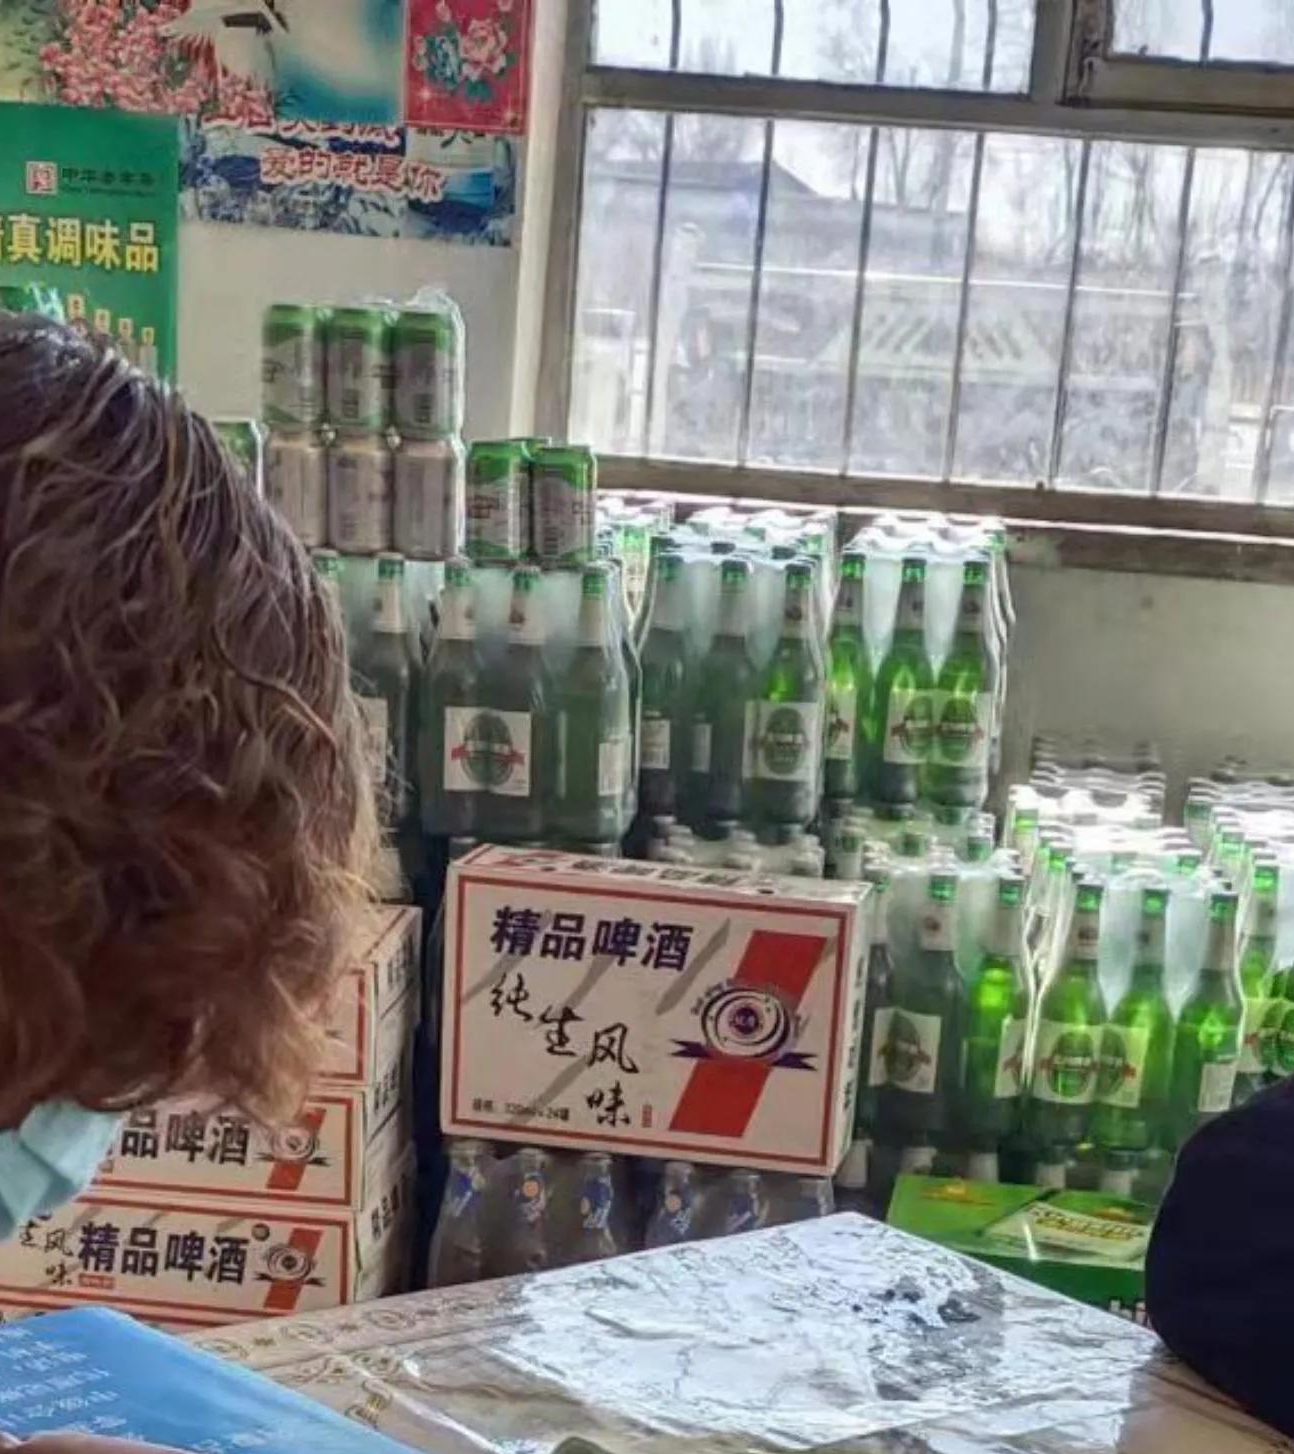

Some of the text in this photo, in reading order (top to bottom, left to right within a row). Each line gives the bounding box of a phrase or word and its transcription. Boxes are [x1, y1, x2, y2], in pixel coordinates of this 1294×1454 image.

[263, 148, 444, 200] 爱的就是你
[490, 905, 695, 971] 精品啤酒
[490, 972, 639, 1127] 纯生风味
[120, 1109, 251, 1167] 品啤酒
[77, 1220, 251, 1285] 精品啤酒
